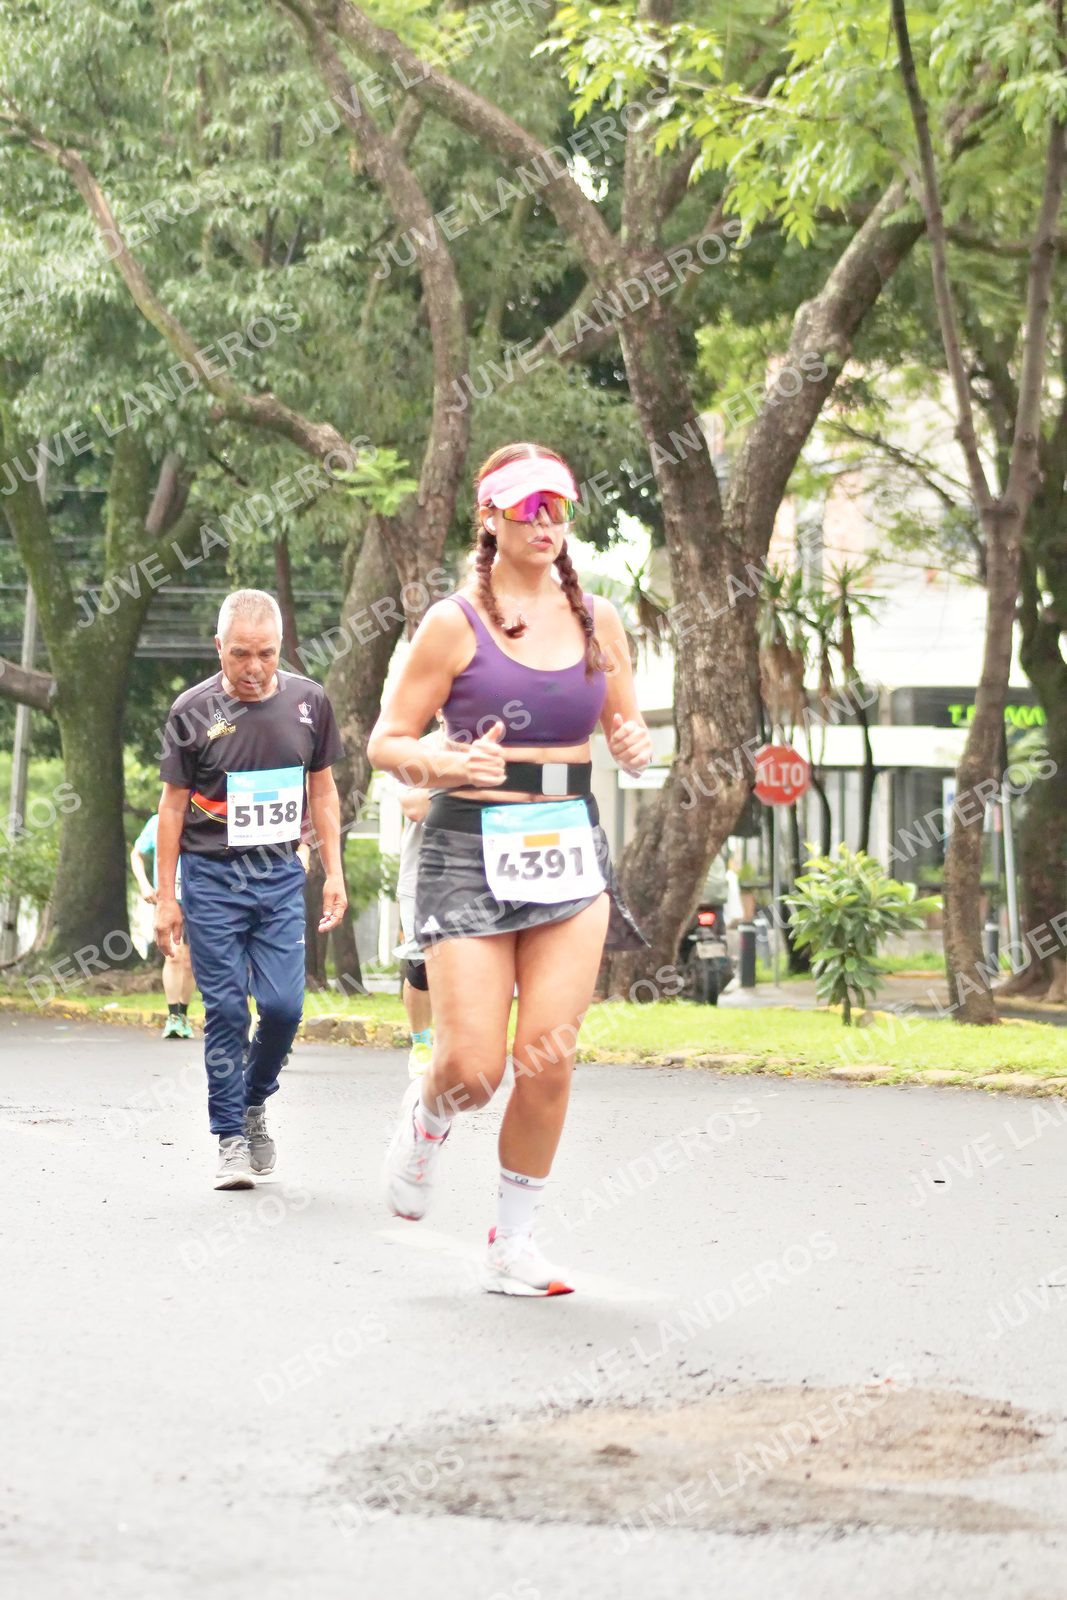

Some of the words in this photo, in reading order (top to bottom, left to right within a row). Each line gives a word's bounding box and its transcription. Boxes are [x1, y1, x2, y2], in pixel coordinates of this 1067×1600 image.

[755, 761, 805, 787] ALTO
[234, 800, 298, 828] 5138
[496, 846, 584, 881] 4391
